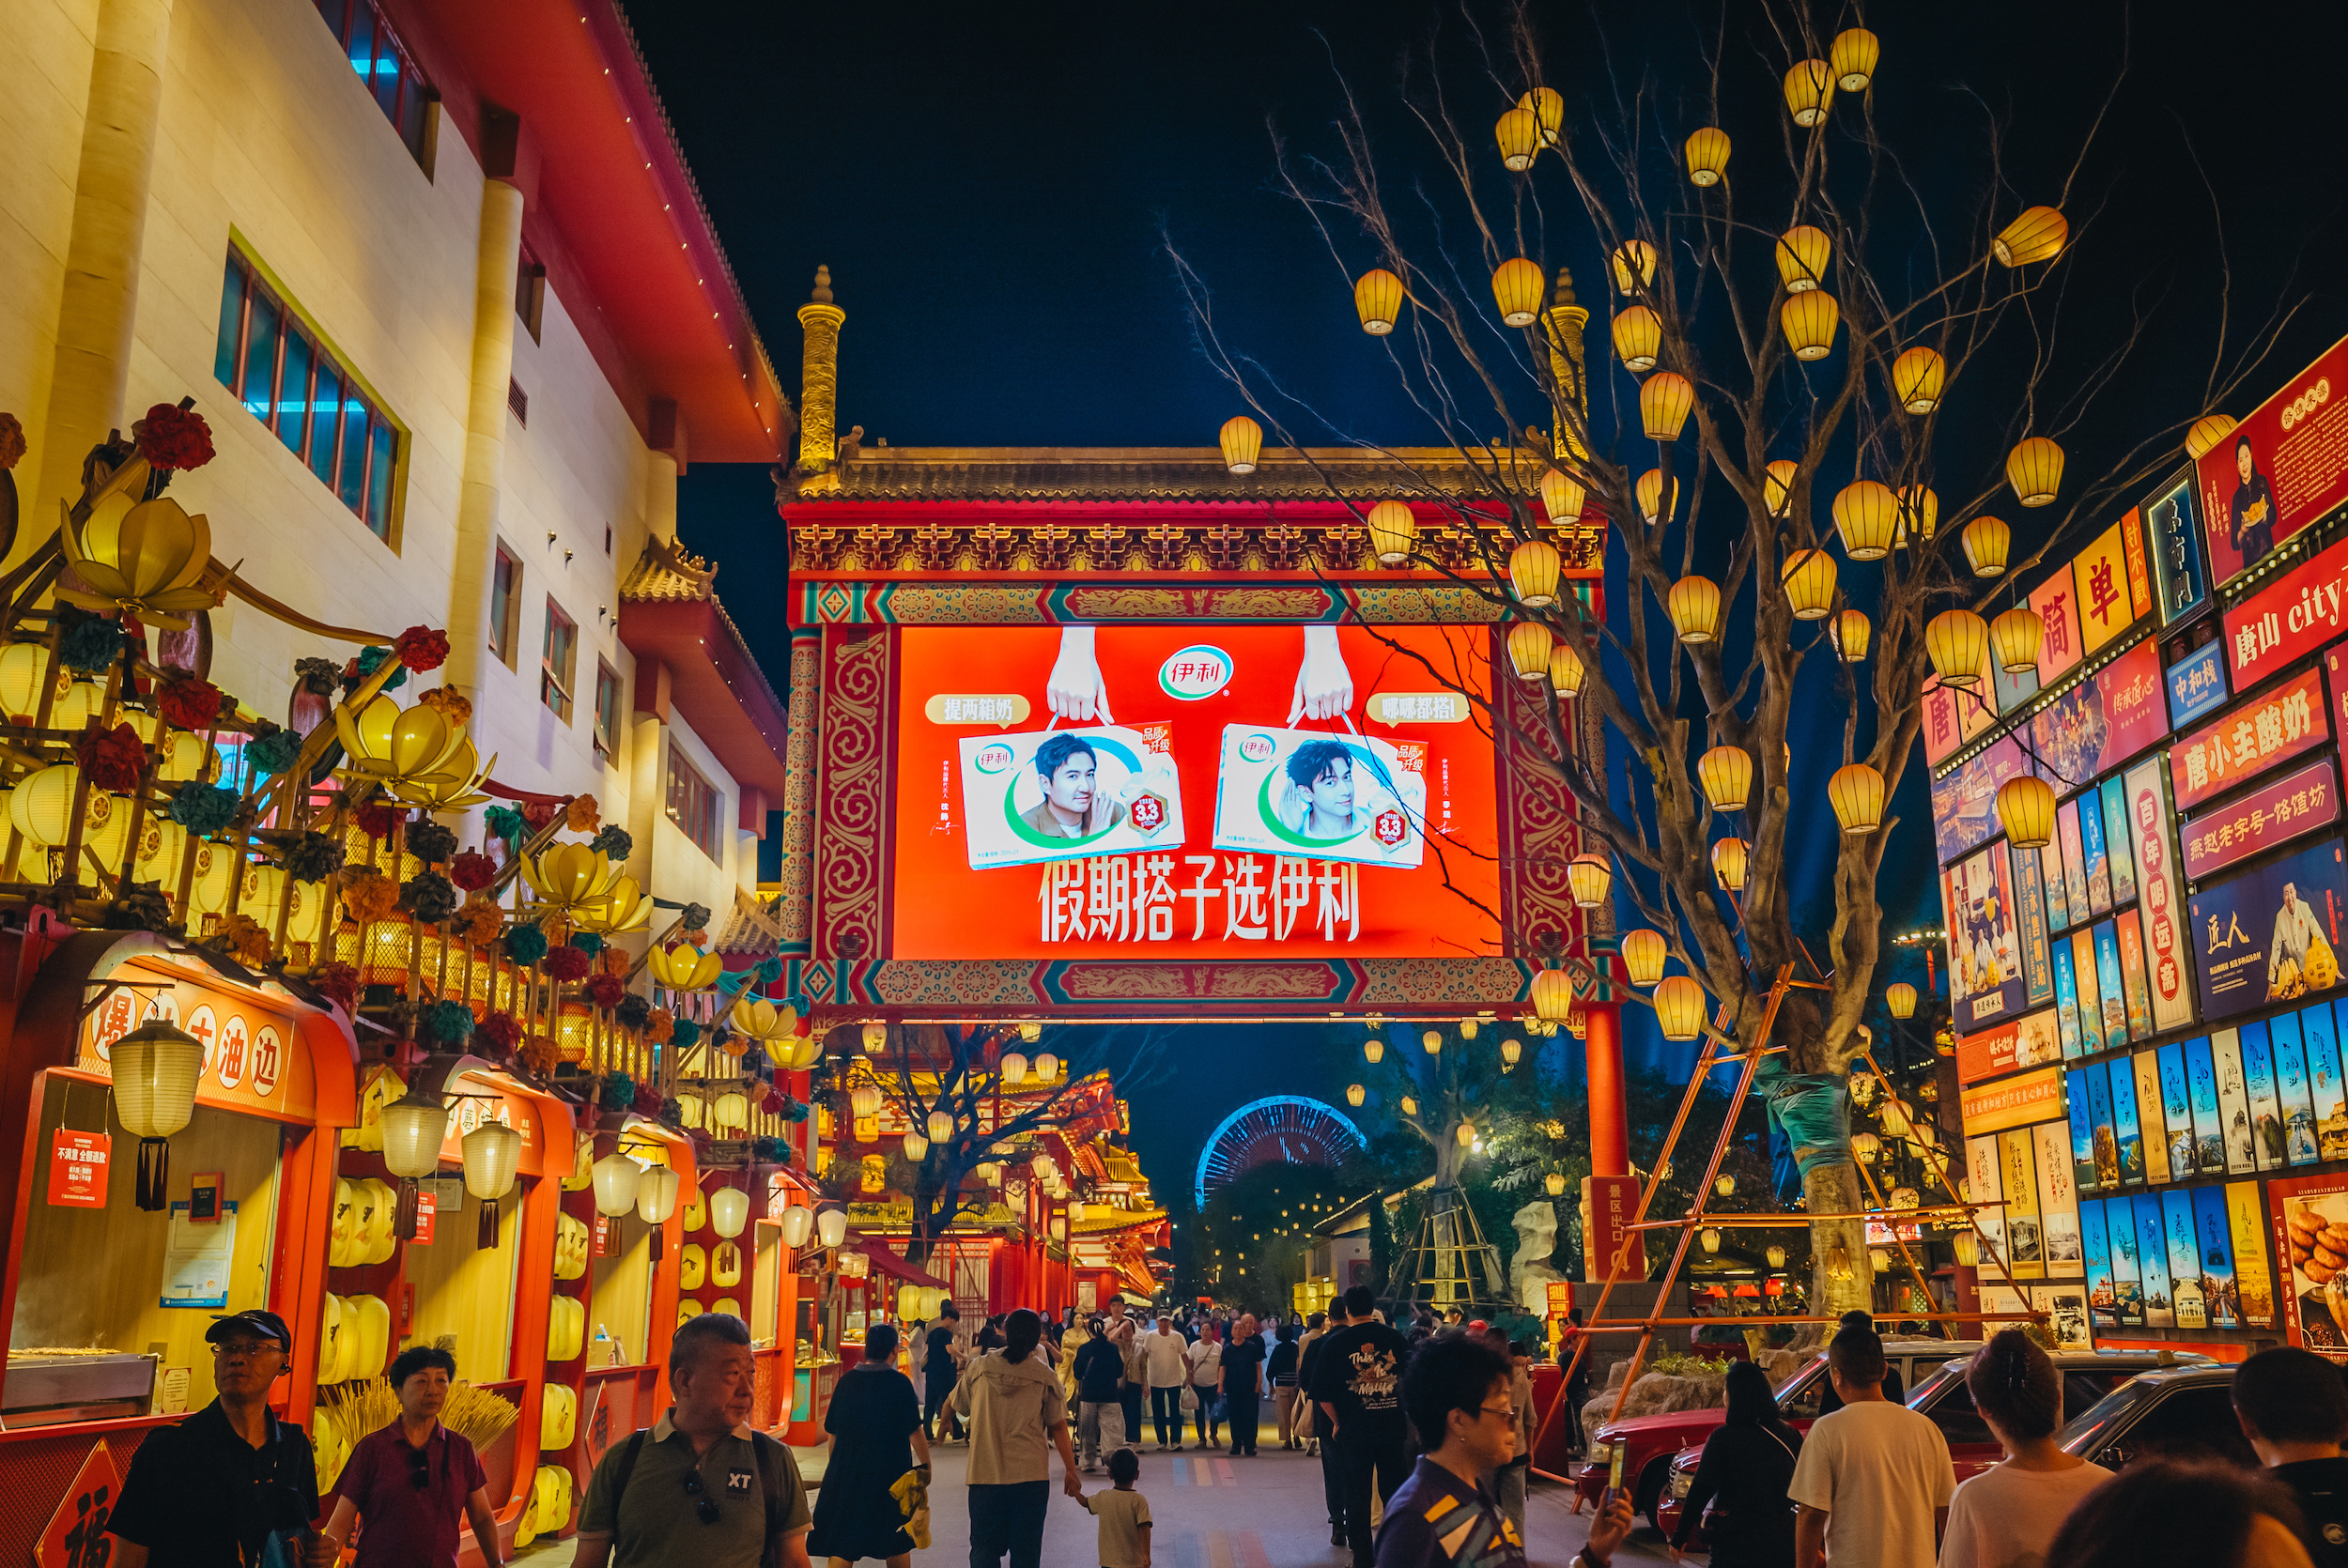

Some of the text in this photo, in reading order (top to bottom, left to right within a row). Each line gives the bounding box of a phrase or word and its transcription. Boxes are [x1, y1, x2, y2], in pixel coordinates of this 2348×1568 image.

[2235, 612, 2281, 670] 唐山
[1171, 663, 1220, 683] 伊利
[2175, 658, 2217, 703] 中和栈
[2113, 673, 2155, 715] 传承匠心
[944, 698, 1013, 721] 提两箱奶
[1143, 727, 1166, 742] 品质
[2184, 688, 2310, 793] 唐小主酸奶
[1150, 739, 1170, 754] 升级
[1244, 742, 1270, 754] 伊利
[1398, 745, 1421, 759] 品质
[981, 752, 1008, 765] 伊利
[1402, 759, 1424, 772] 升级
[1135, 804, 1159, 822] 3.3
[1379, 819, 1401, 838] 3.3
[1037, 854, 1361, 943] 假期搭子选伊利
[2139, 795, 2176, 993] 百年明远斋
[2207, 910, 2250, 955] 匠人
[57, 1147, 106, 1163] 不满意 全额退款
[1609, 1184, 1623, 1242] 景区出口
[594, 1405, 608, 1453] 福
[728, 1472, 751, 1489] XT
